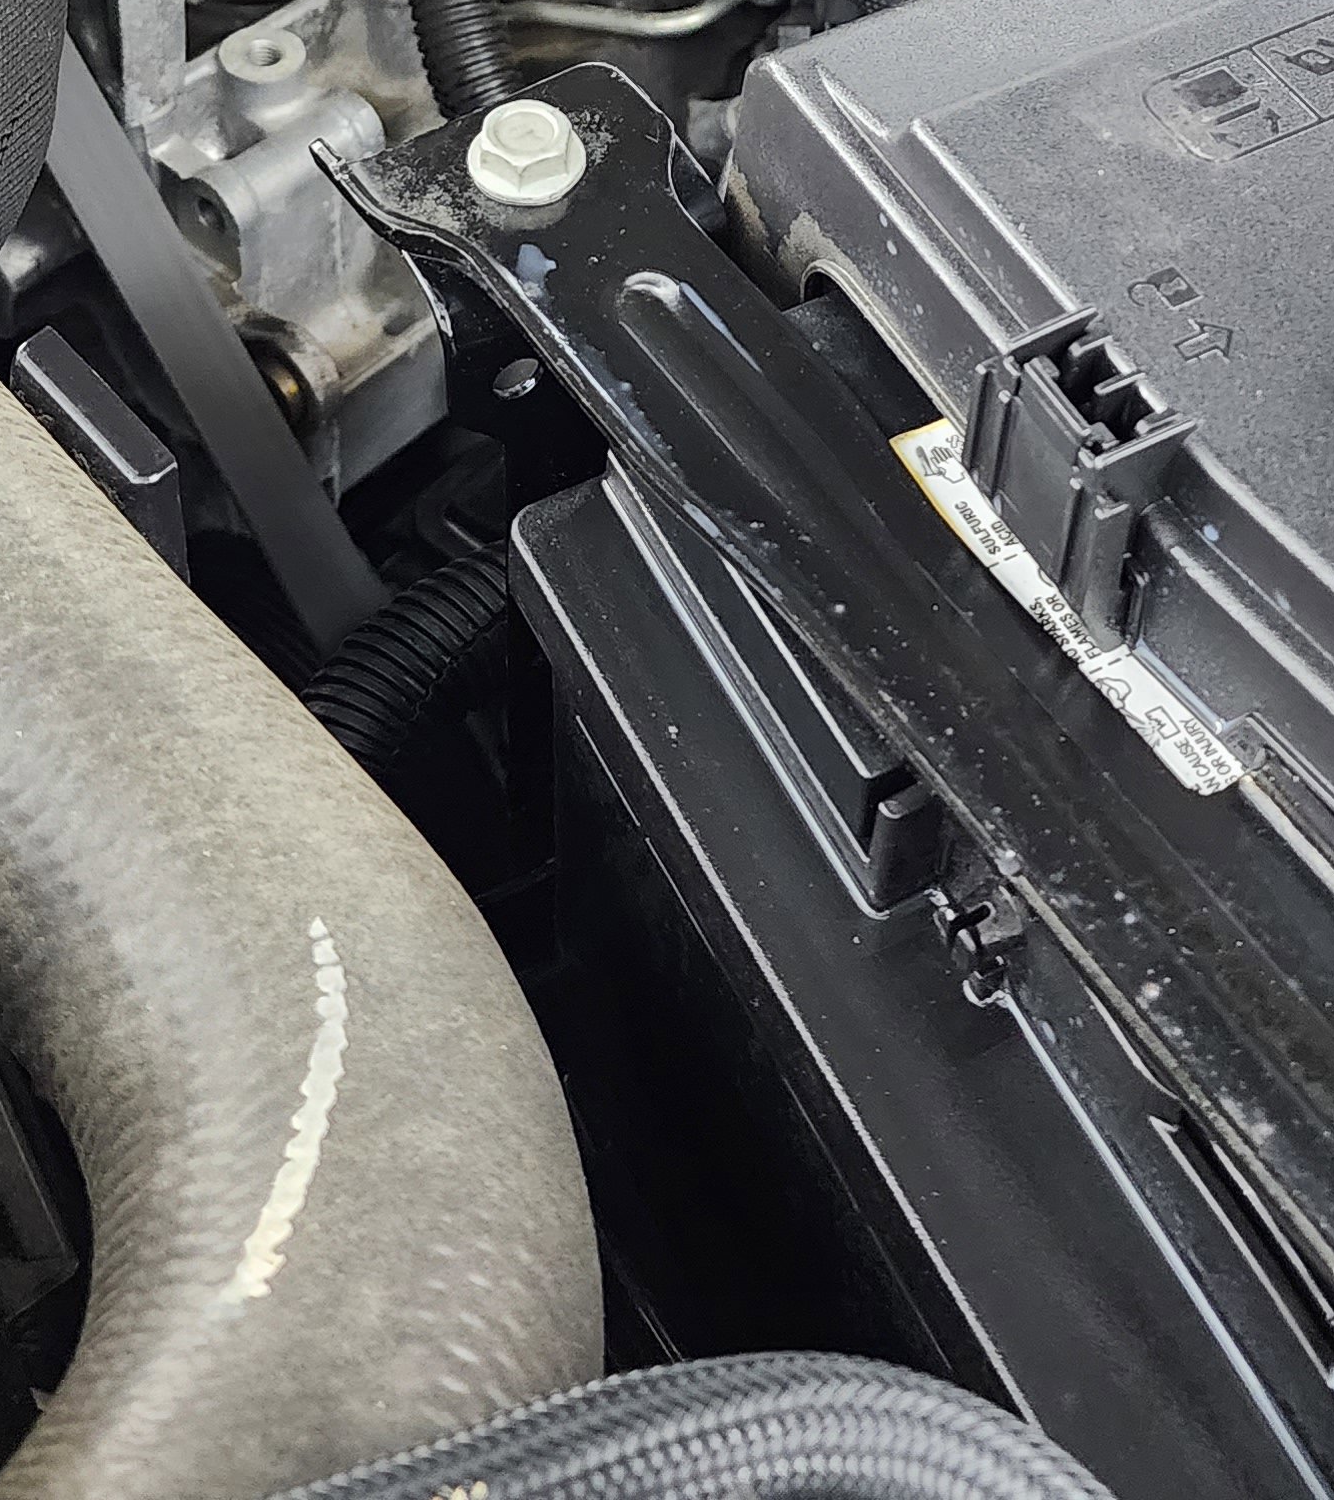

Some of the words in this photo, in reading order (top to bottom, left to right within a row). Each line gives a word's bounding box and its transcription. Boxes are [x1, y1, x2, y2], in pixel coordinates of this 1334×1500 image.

[955, 501, 1001, 555] SULFURIC
[991, 520, 1019, 546] ACID
[1045, 593, 1065, 612] OR
[1059, 613, 1103, 659] FLAMES
[1174, 736, 1211, 777] CAUSE
[1179, 718, 1218, 757] INJURY
[1211, 756, 1231, 775] OR
